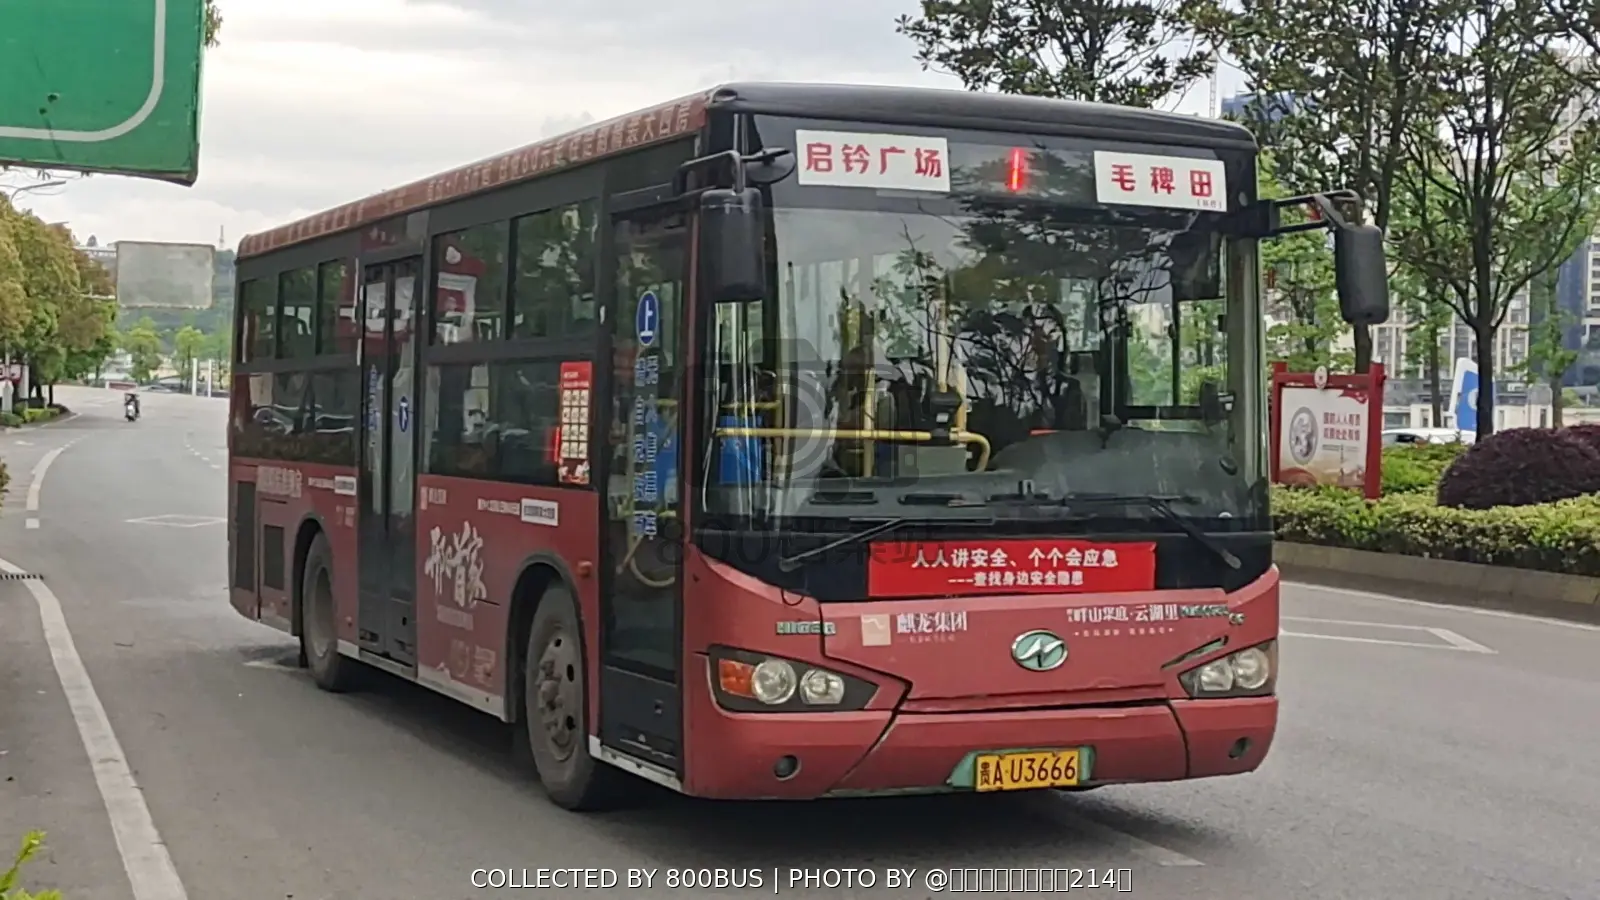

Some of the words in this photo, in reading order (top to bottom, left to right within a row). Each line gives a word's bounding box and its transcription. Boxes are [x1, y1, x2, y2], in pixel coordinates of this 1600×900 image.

[806, 142, 942, 178] 启钤广场
[1111, 163, 1213, 198] 毛稗田
[912, 547, 1119, 568] 人人讲安全、个个会应急
